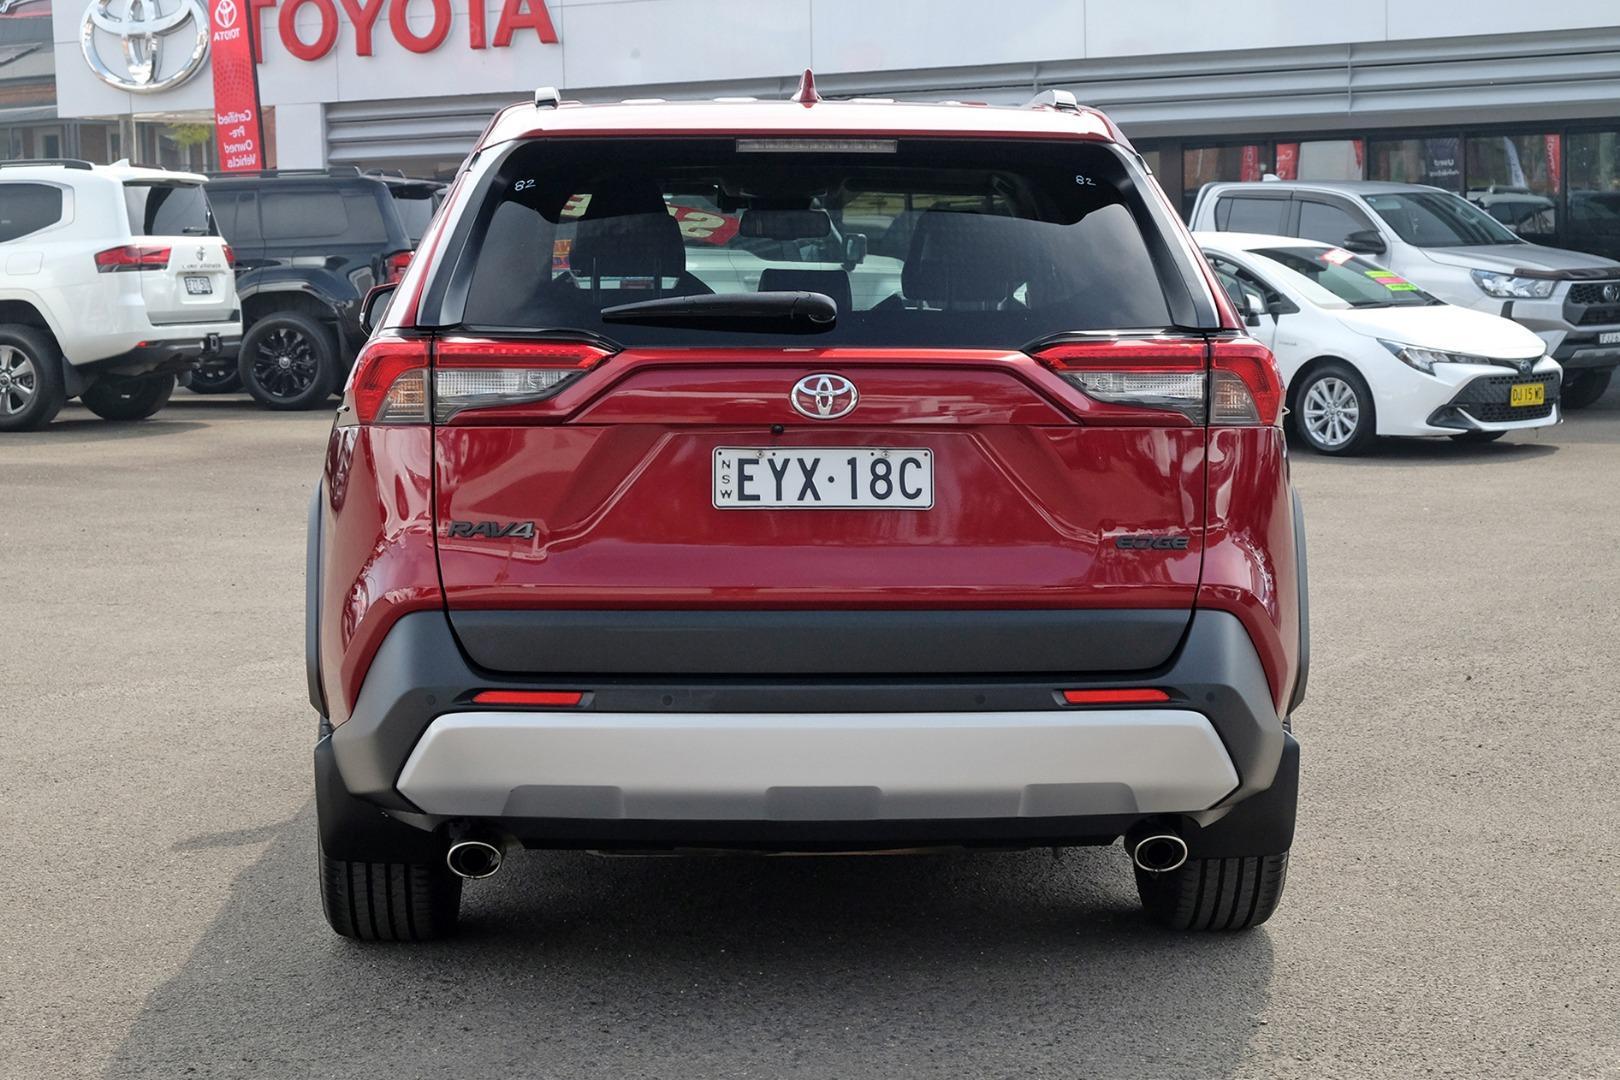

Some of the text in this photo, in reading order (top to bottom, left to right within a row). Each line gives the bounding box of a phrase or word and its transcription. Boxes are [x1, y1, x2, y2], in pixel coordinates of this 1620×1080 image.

[514, 179, 537, 191] 82
[1075, 175, 1097, 185] 82
[447, 520, 535, 539] RAV4
[1115, 534, 1190, 550] EDGE
